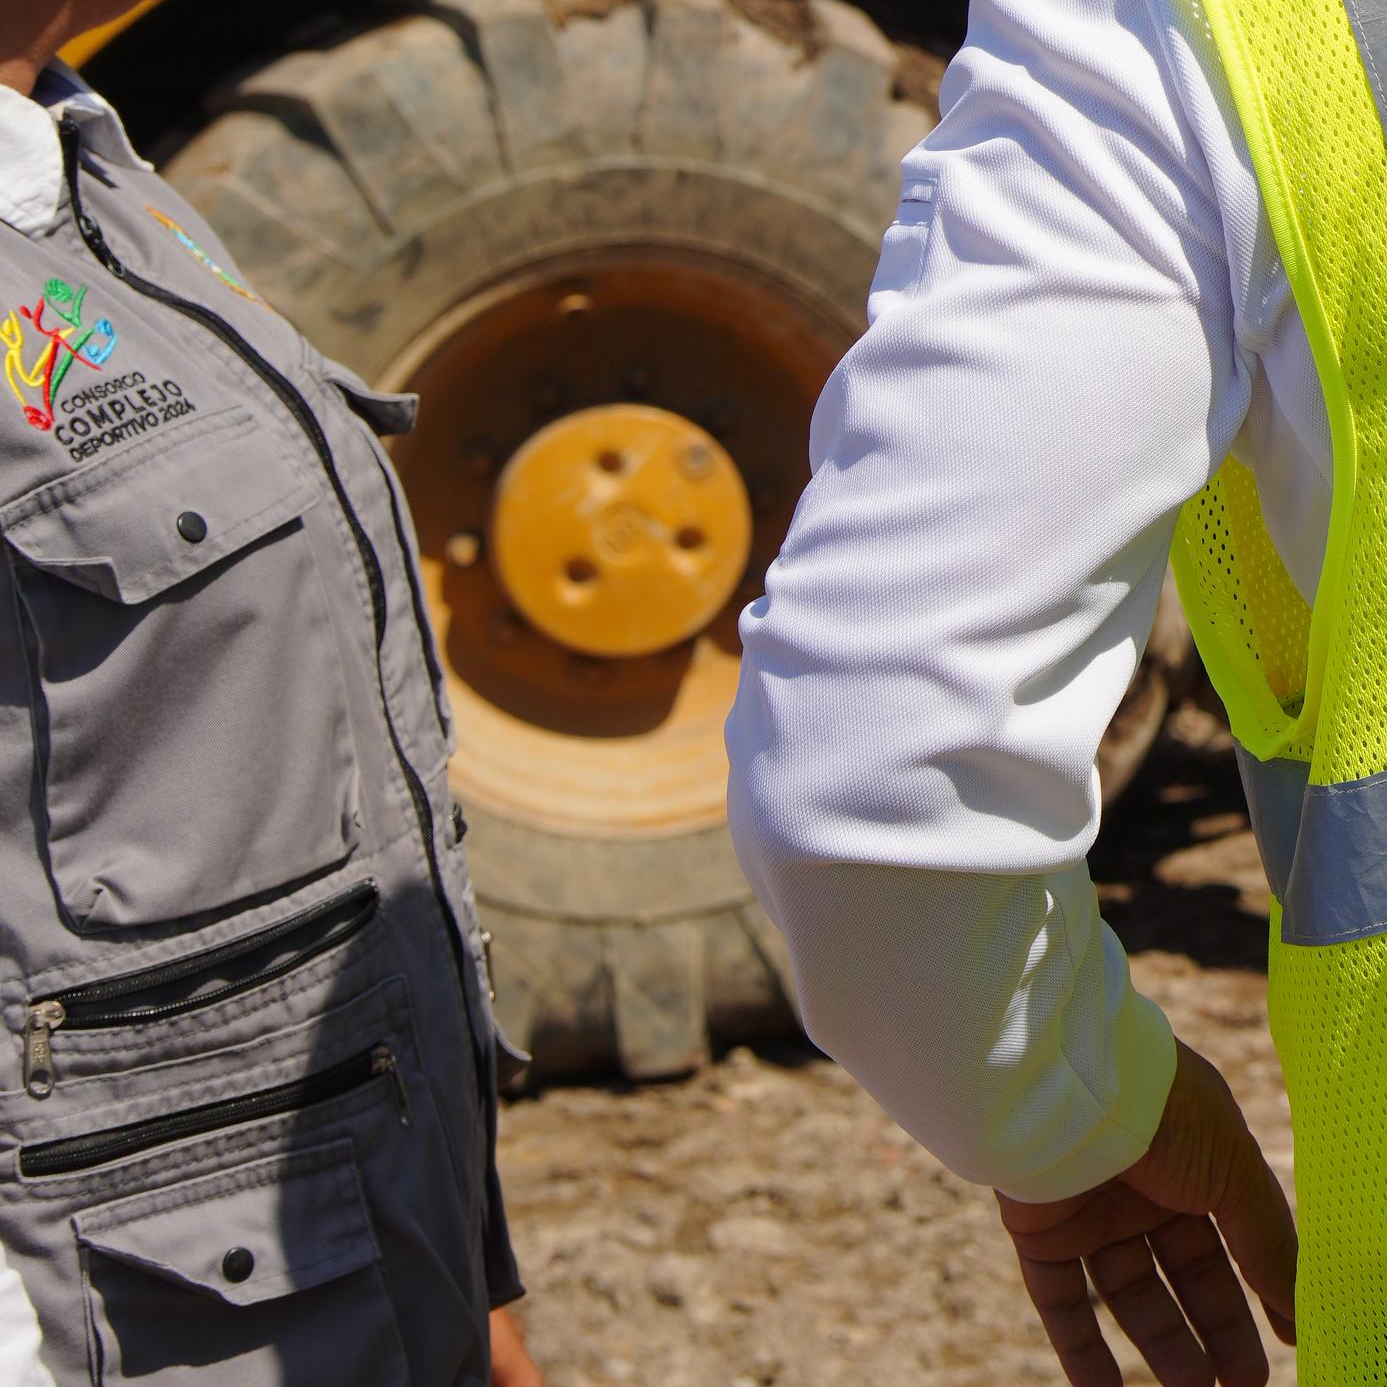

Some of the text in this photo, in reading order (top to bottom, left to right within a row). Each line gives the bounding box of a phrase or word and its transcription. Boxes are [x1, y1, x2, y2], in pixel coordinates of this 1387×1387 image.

[54, 379, 182, 446] COMPLEJO
[68, 398, 196, 463] DEPORTIVO 2024
